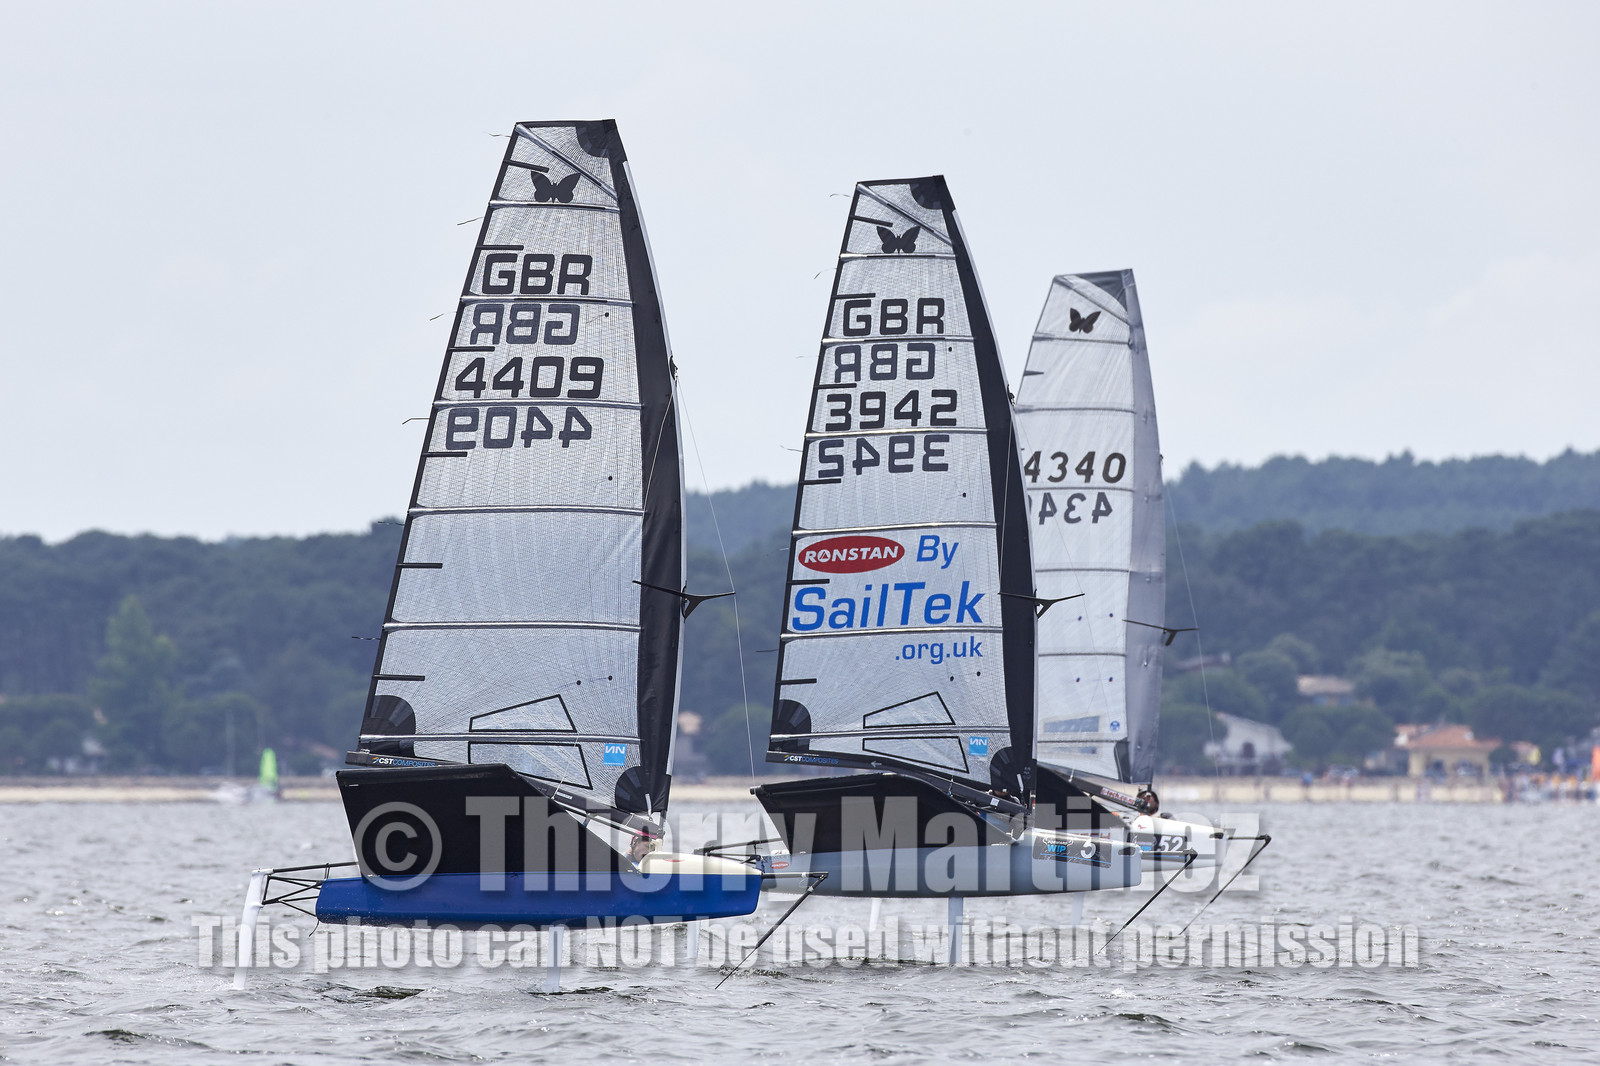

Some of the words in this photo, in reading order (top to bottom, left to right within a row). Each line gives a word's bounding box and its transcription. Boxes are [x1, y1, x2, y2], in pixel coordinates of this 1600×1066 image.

[481, 253, 593, 295] GBR
[843, 297, 945, 336] GBR
[454, 356, 604, 399] 4409
[825, 389, 958, 431] 3942
[1024, 451, 1127, 484] 4340
[803, 545, 900, 564] RONSTAN
[916, 534, 960, 569] By
[791, 580, 986, 631] SailTek
[895, 635, 983, 665] .org.uk
[1047, 844, 1067, 853] WIP
[1156, 835, 1184, 852] 52
